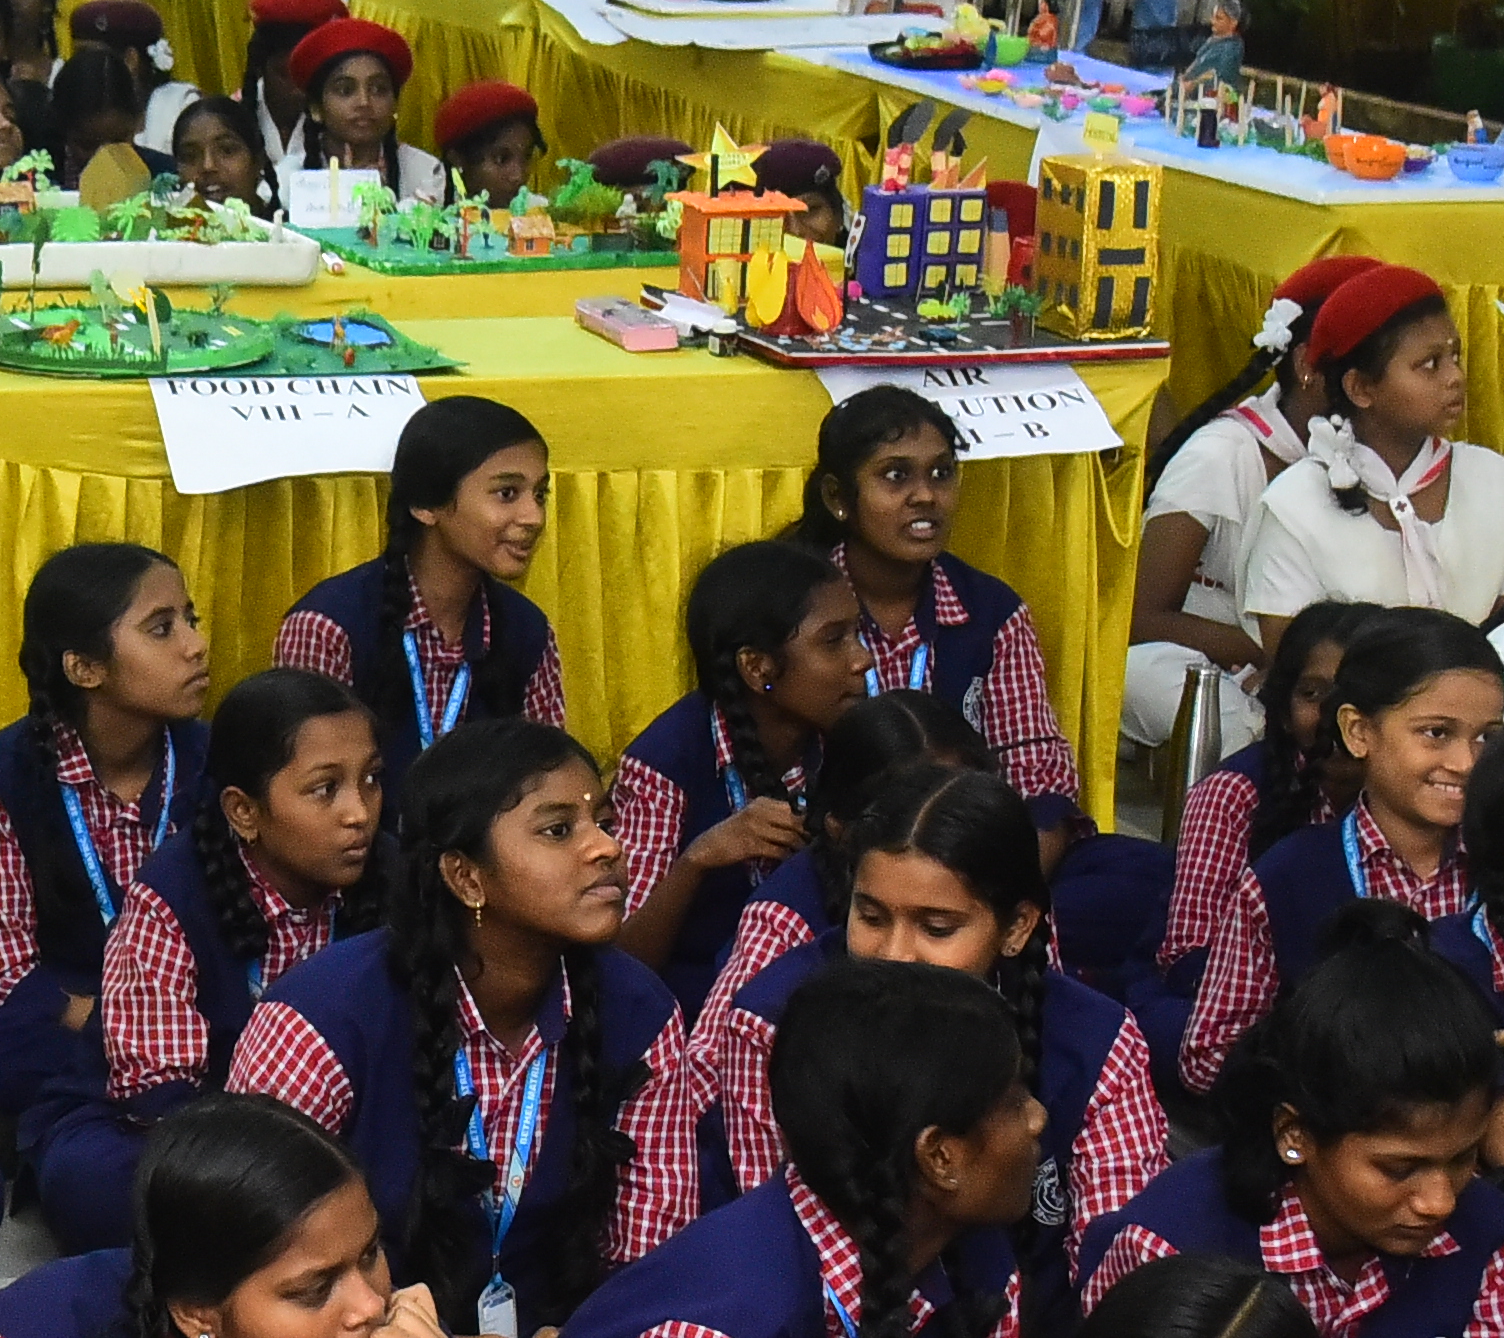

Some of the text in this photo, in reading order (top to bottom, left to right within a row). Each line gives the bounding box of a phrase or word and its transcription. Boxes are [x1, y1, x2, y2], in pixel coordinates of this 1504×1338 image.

[166, 375, 415, 398] FOOD CHAIN
[923, 367, 990, 388] AIR
[231, 403, 304, 422] VIII
[344, 403, 372, 419] A
[1021, 422, 1051, 439] B
[519, 1106, 535, 1146] BETHEL
